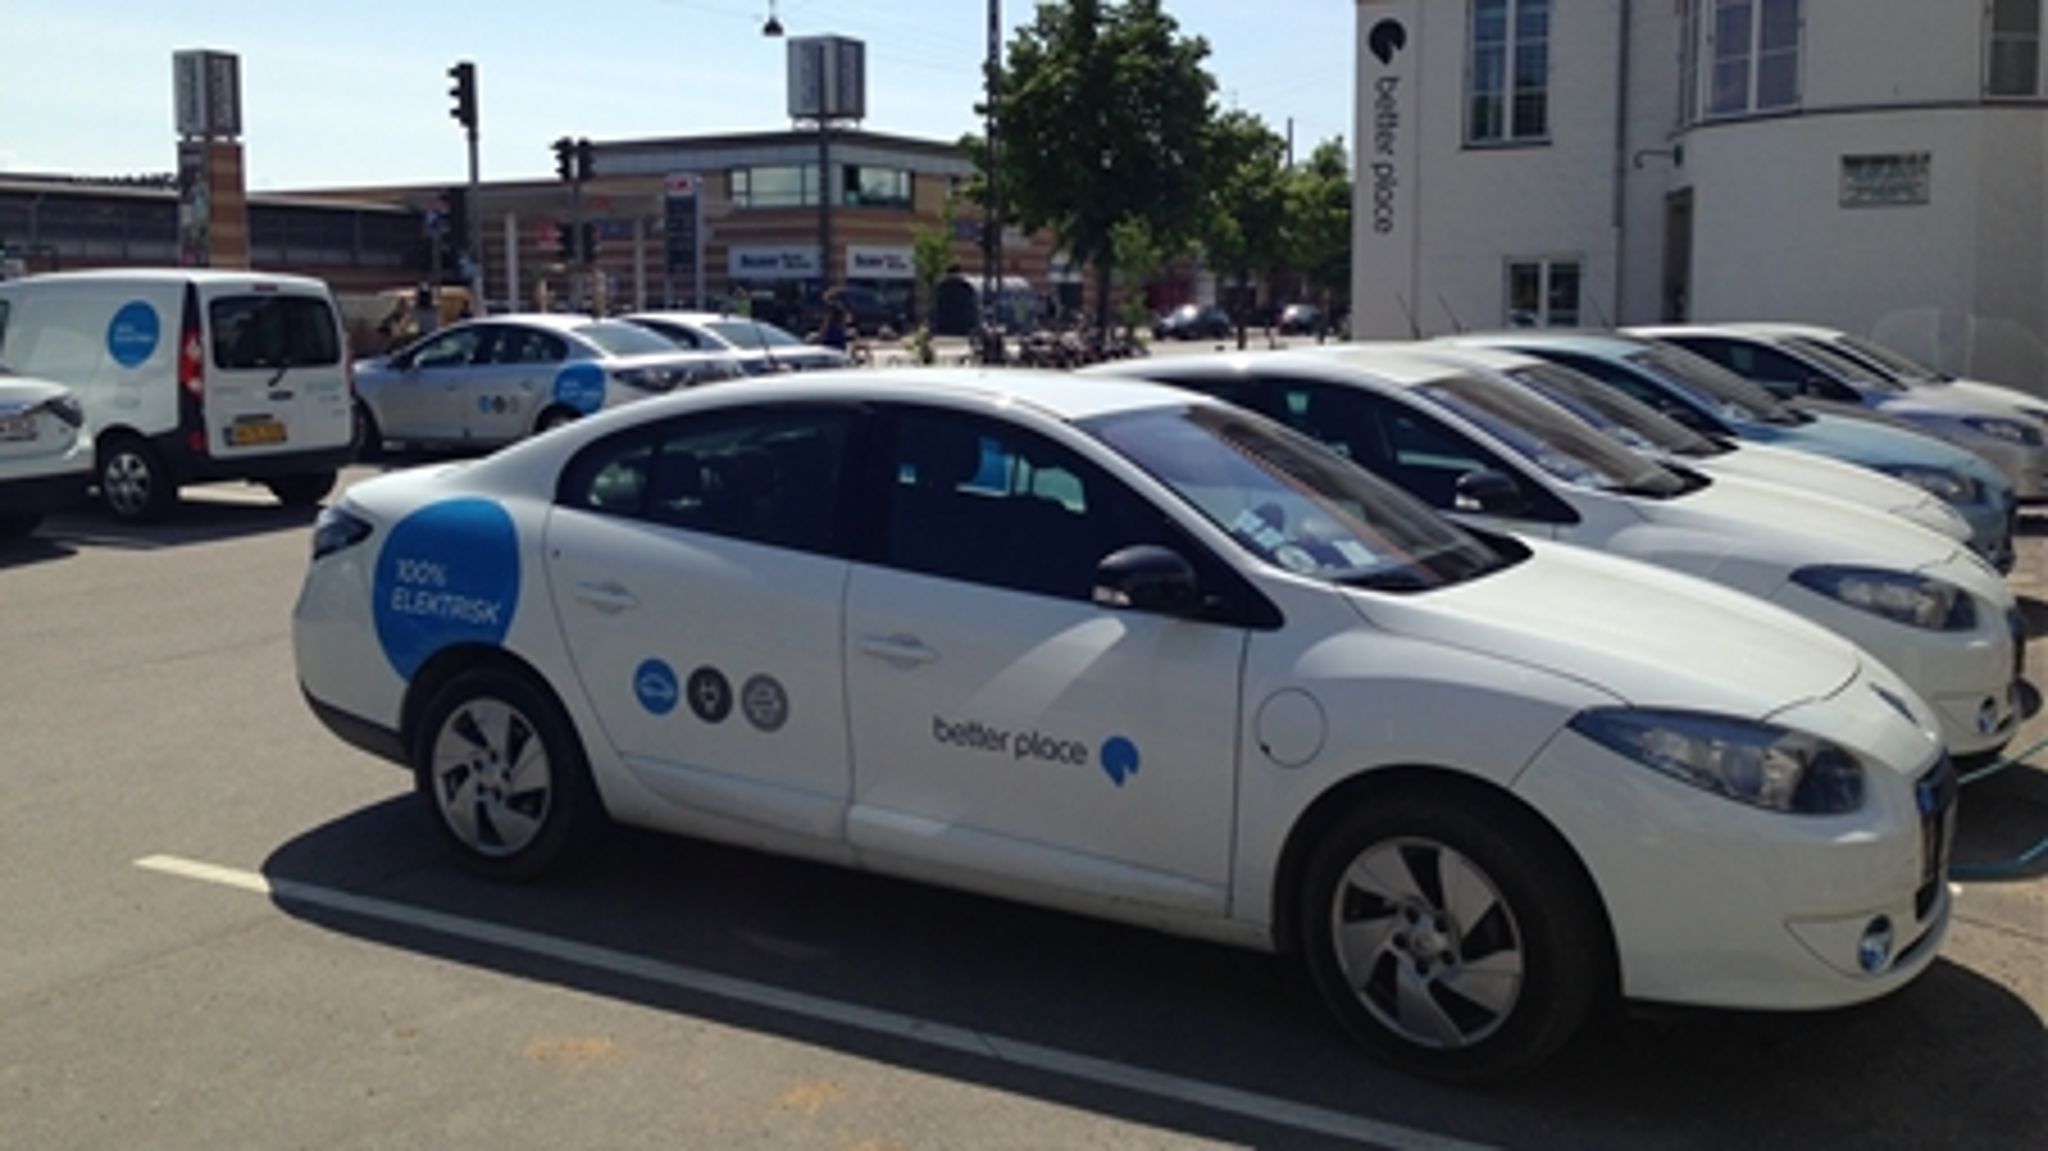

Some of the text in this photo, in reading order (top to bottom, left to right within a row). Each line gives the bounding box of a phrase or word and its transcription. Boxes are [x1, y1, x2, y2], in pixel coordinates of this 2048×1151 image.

[1370, 76, 1399, 234] better place
[397, 559, 446, 586] 100%
[392, 588, 501, 624] ELEKTRISK
[932, 714, 1089, 766] better place
